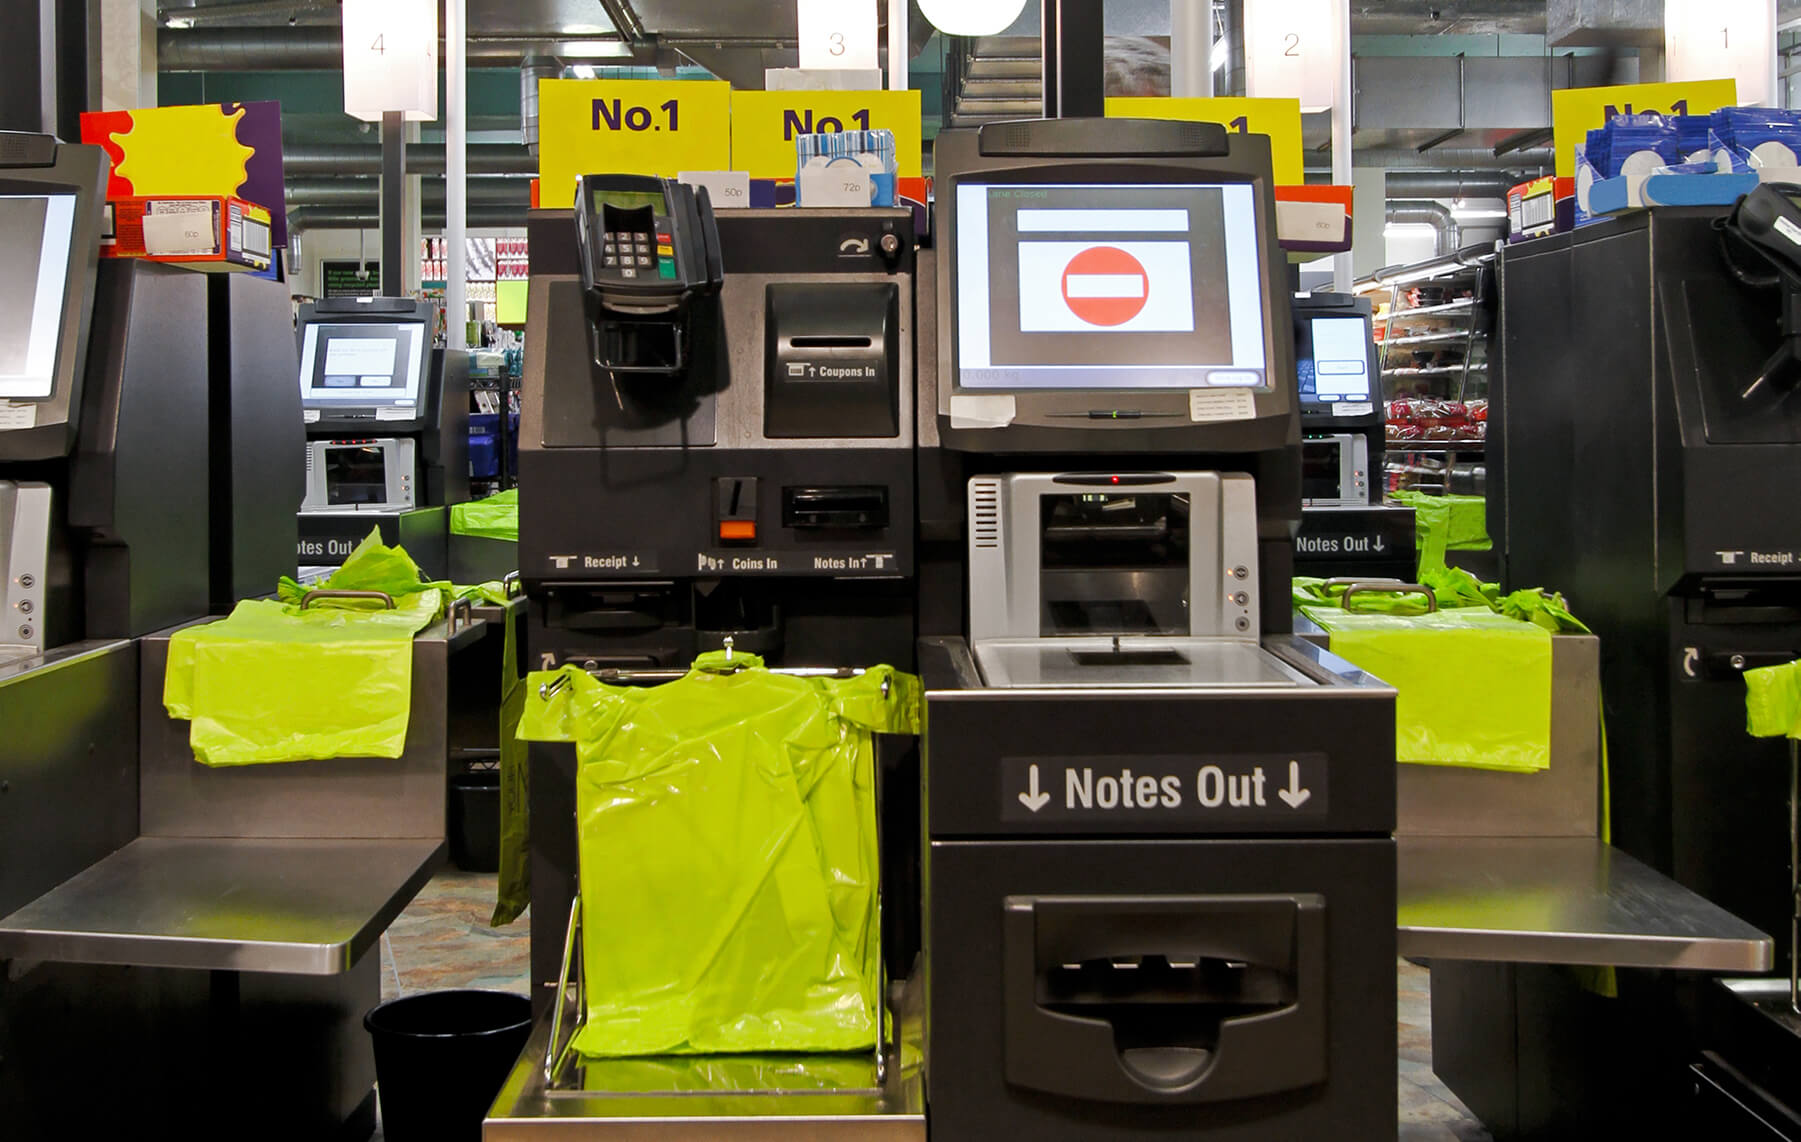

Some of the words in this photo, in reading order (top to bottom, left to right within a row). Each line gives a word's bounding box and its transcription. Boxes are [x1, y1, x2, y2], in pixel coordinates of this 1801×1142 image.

[371, 33, 387, 56] 4
[829, 32, 846, 57] 3
[1284, 33, 1300, 57] 2
[1719, 27, 1728, 49] 1
[592, 98, 679, 132] No.1
[783, 109, 870, 141] No1
[820, 366, 862, 379] Coupons
[865, 366, 875, 377] In
[328, 539, 353, 555] Out
[1296, 537, 1339, 552] Notes
[1343, 536, 1369, 552] Out
[584, 555, 627, 569] Receipt
[732, 557, 763, 570] Coins
[766, 557, 778, 570] In
[814, 557, 846, 569] Notes
[849, 557, 860, 569] In
[1751, 551, 1793, 566] Receipt
[1065, 768, 1182, 808] Notes
[1197, 765, 1266, 808] Out
